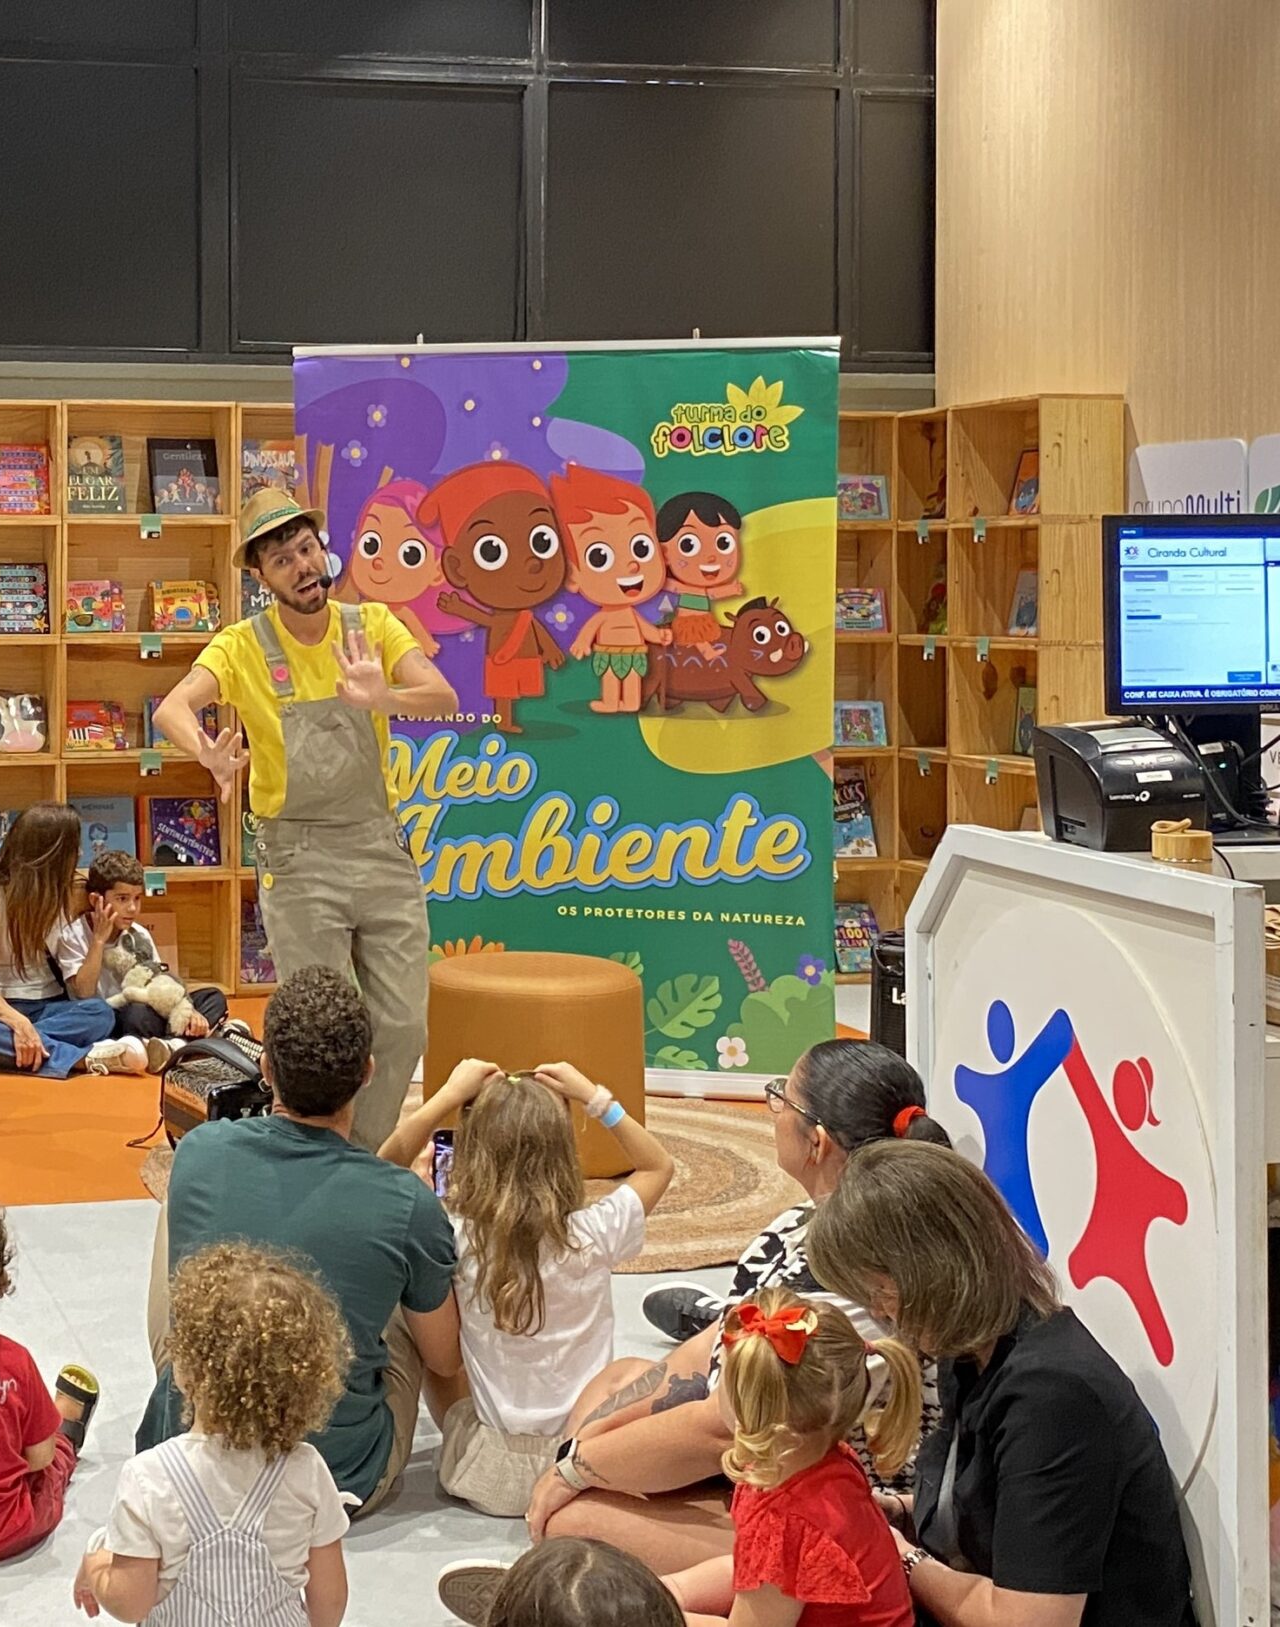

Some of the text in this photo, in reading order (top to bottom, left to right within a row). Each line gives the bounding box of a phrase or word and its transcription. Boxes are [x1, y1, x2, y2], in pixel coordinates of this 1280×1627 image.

[673, 405, 767, 424] turma do
[652, 423, 787, 456] folclore
[66, 486, 119, 501] FELIZ
[1147, 547, 1228, 558] Ciranda Cultural
[481, 713, 502, 724] DO
[390, 736, 531, 801] Meio
[557, 905, 806, 926] OS PROTETORES DA NATUREZA
